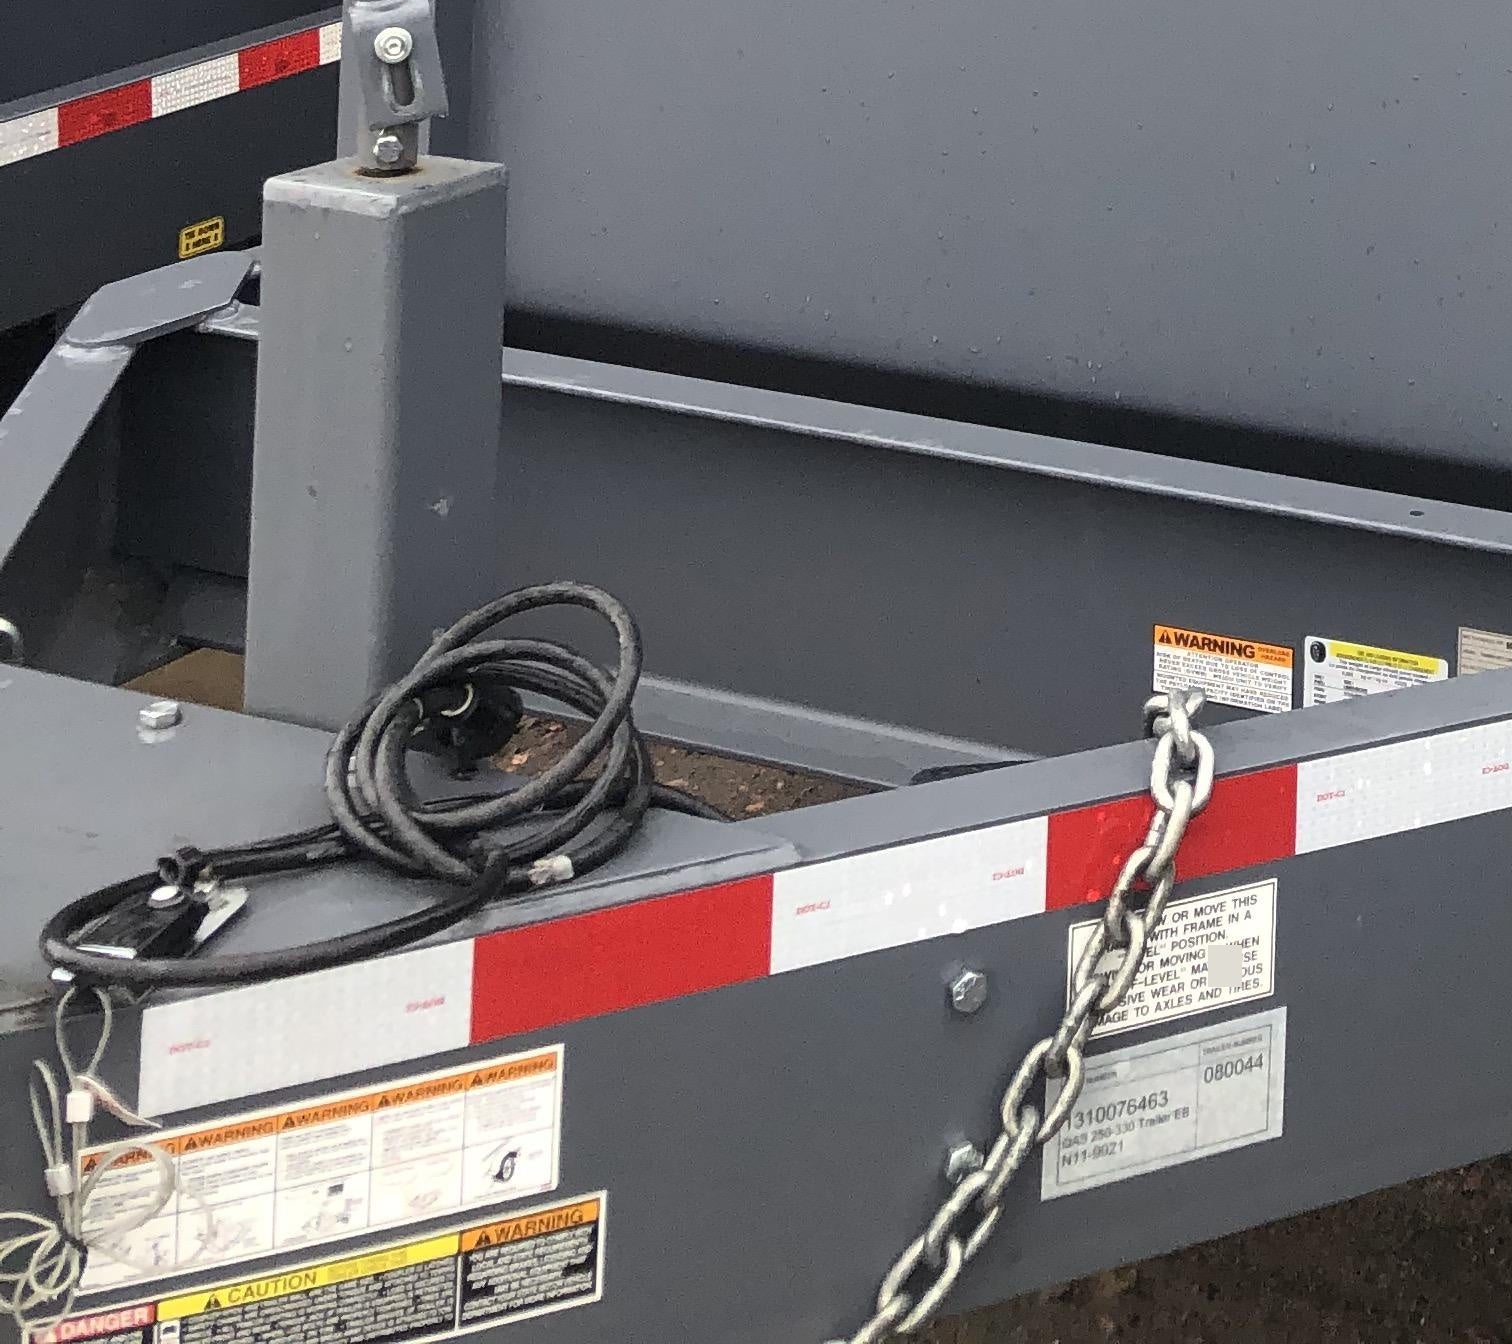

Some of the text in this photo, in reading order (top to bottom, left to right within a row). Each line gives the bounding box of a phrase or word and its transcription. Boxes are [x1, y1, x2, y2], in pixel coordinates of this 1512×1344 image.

[1174, 631, 1256, 659] WARNING
[1171, 910, 1188, 923] OR
[1194, 901, 1226, 918] MOVE
[1232, 894, 1257, 909] THIS
[1148, 926, 1178, 942] WITH
[1183, 915, 1222, 934] FRAME
[1228, 912, 1238, 924] IN
[1244, 909, 1251, 920] A
[1138, 960, 1154, 973] OR
[1160, 948, 1205, 967] MOVING
[1226, 935, 1259, 951] HEN
[1191, 962, 1208, 975] MA
[1134, 1004, 1148, 1018] TO
[1154, 993, 1192, 1012] AXLES
[1198, 987, 1221, 1001] AND
[1151, 976, 1206, 999] WEAR OR
[486, 1059, 554, 1083] WARNING
[1204, 1052, 1263, 1084] 080044
[392, 1078, 463, 1104] WARNING
[298, 1100, 370, 1125] WARNING
[1064, 1088, 1168, 1132] 1310076463
[199, 1122, 274, 1148] WARNING
[495, 1208, 584, 1240] WARNING
[228, 1271, 317, 1305] CAUTION
[60, 1308, 149, 1339] DANGER
